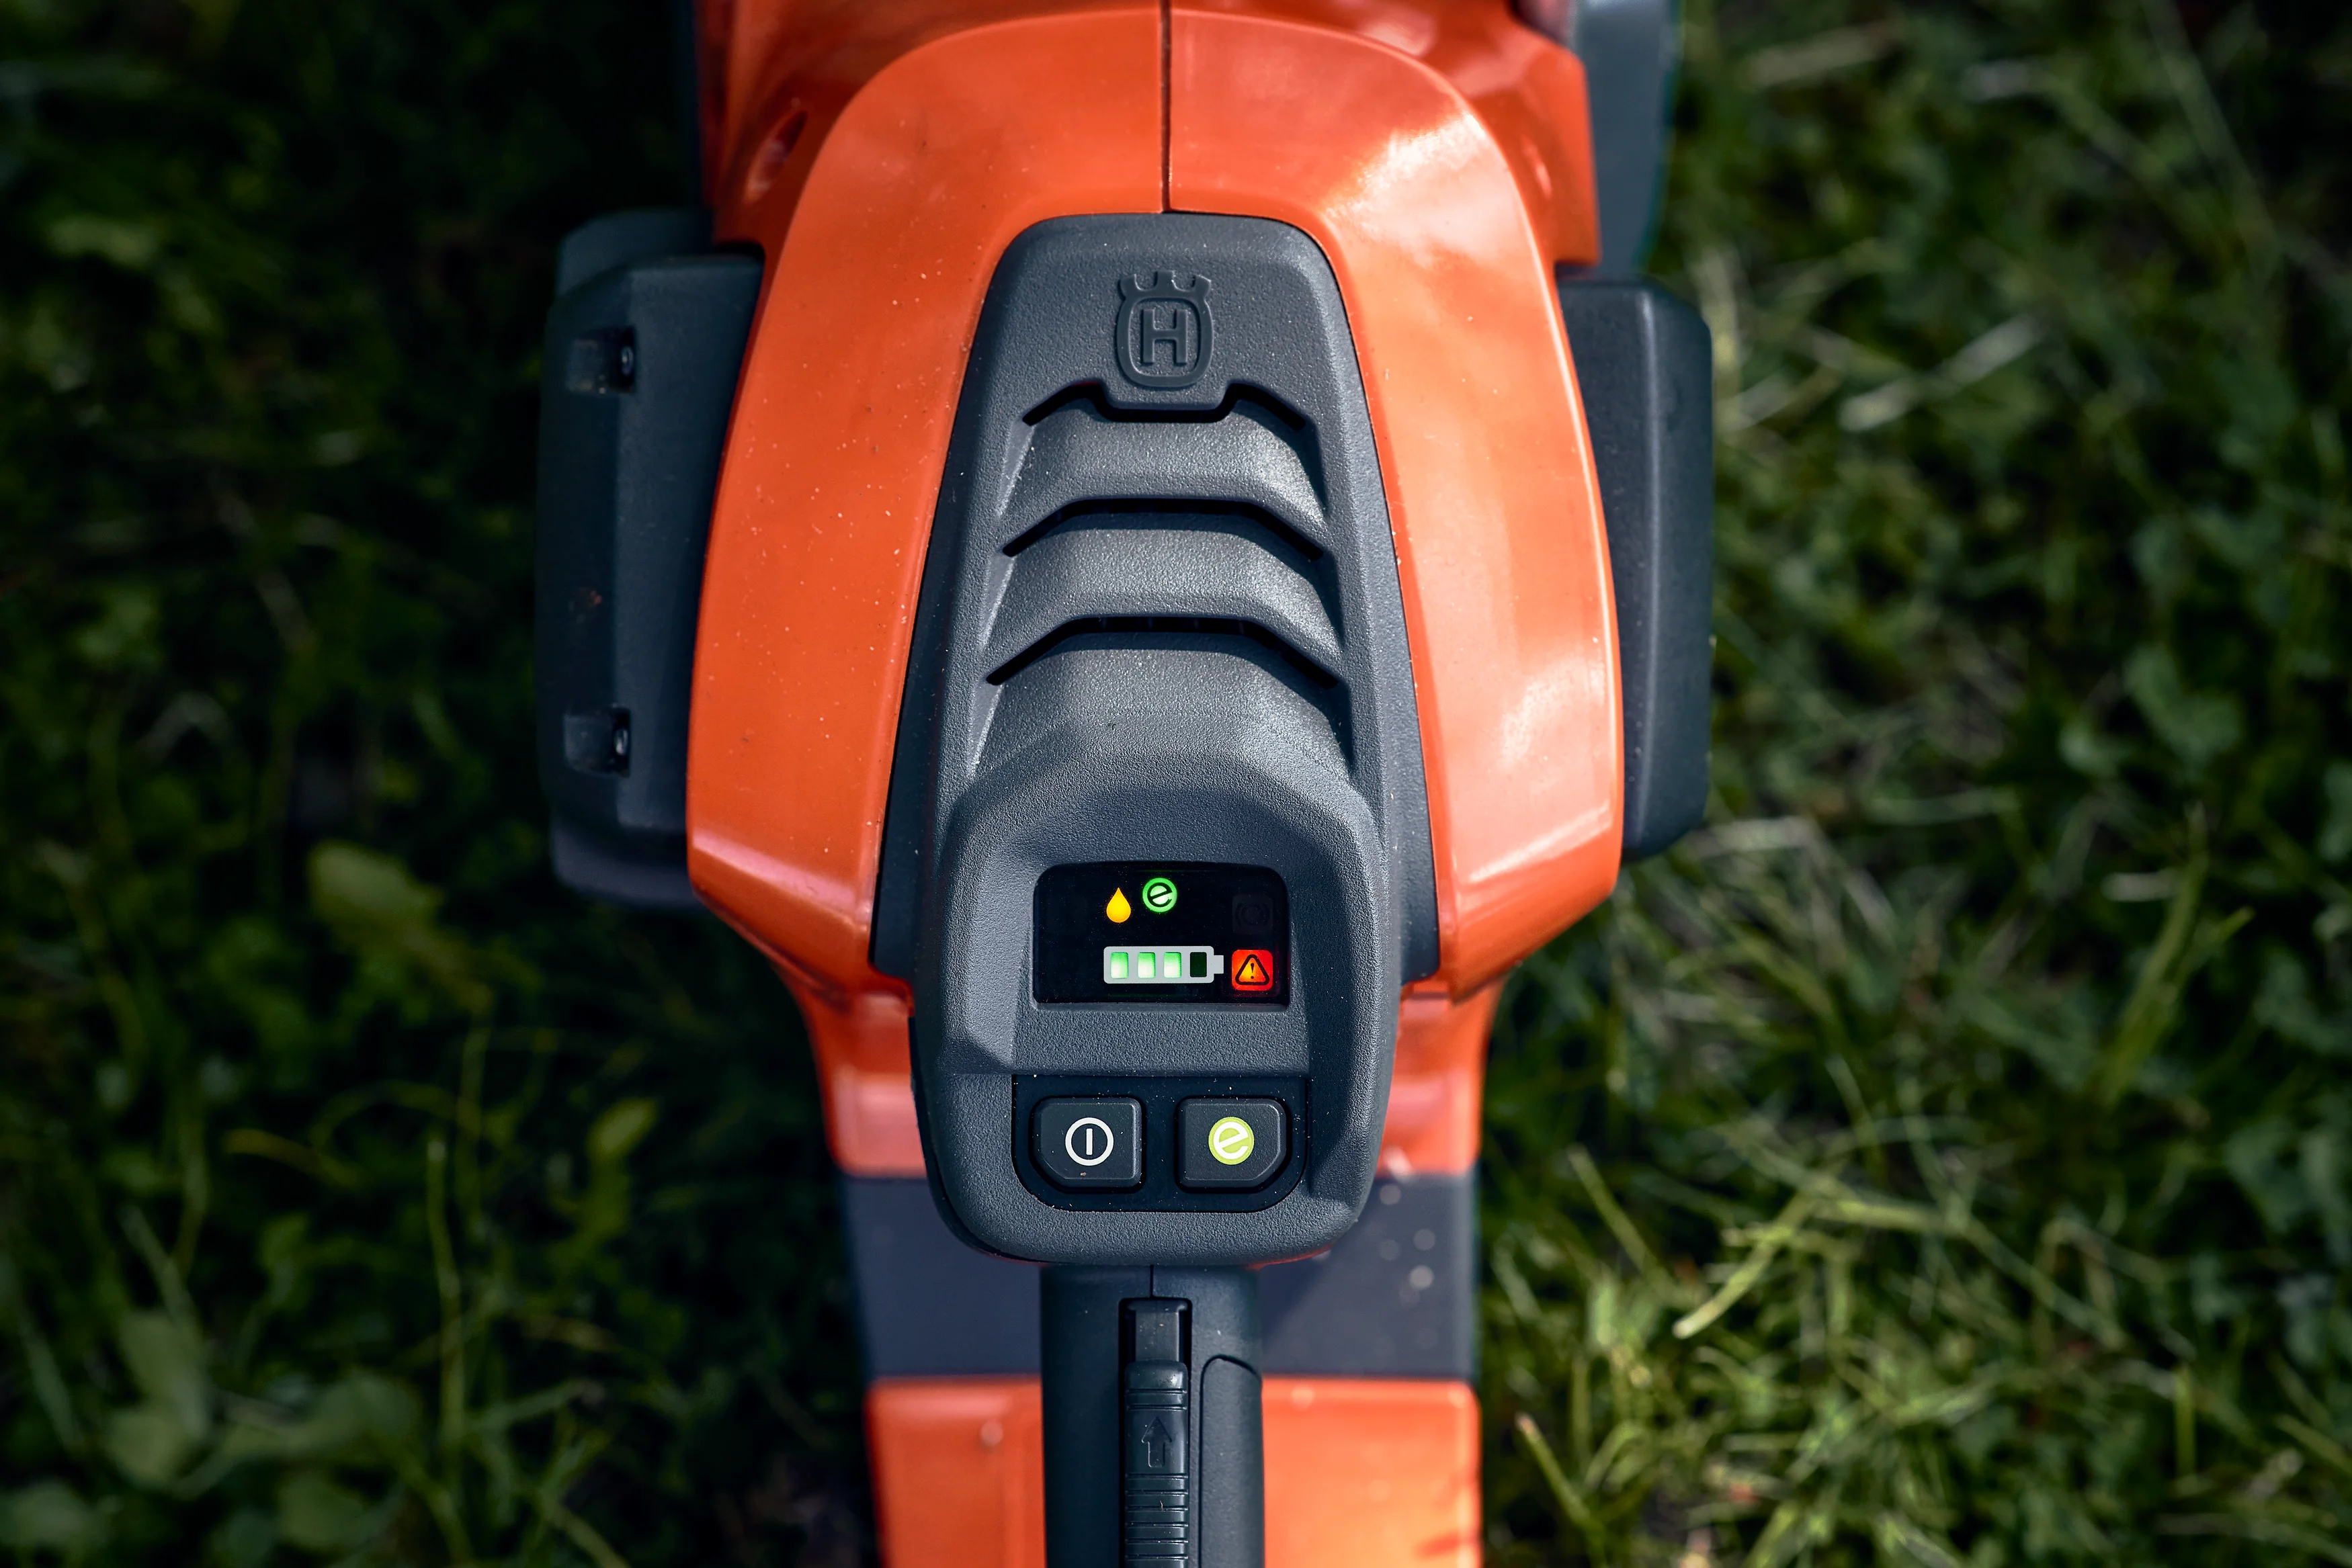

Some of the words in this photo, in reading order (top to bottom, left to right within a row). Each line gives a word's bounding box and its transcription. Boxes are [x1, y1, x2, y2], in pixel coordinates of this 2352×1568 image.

[1141, 309, 1187, 364] H
[1146, 882, 1173, 908] e
[1213, 1121, 1249, 1160] e
